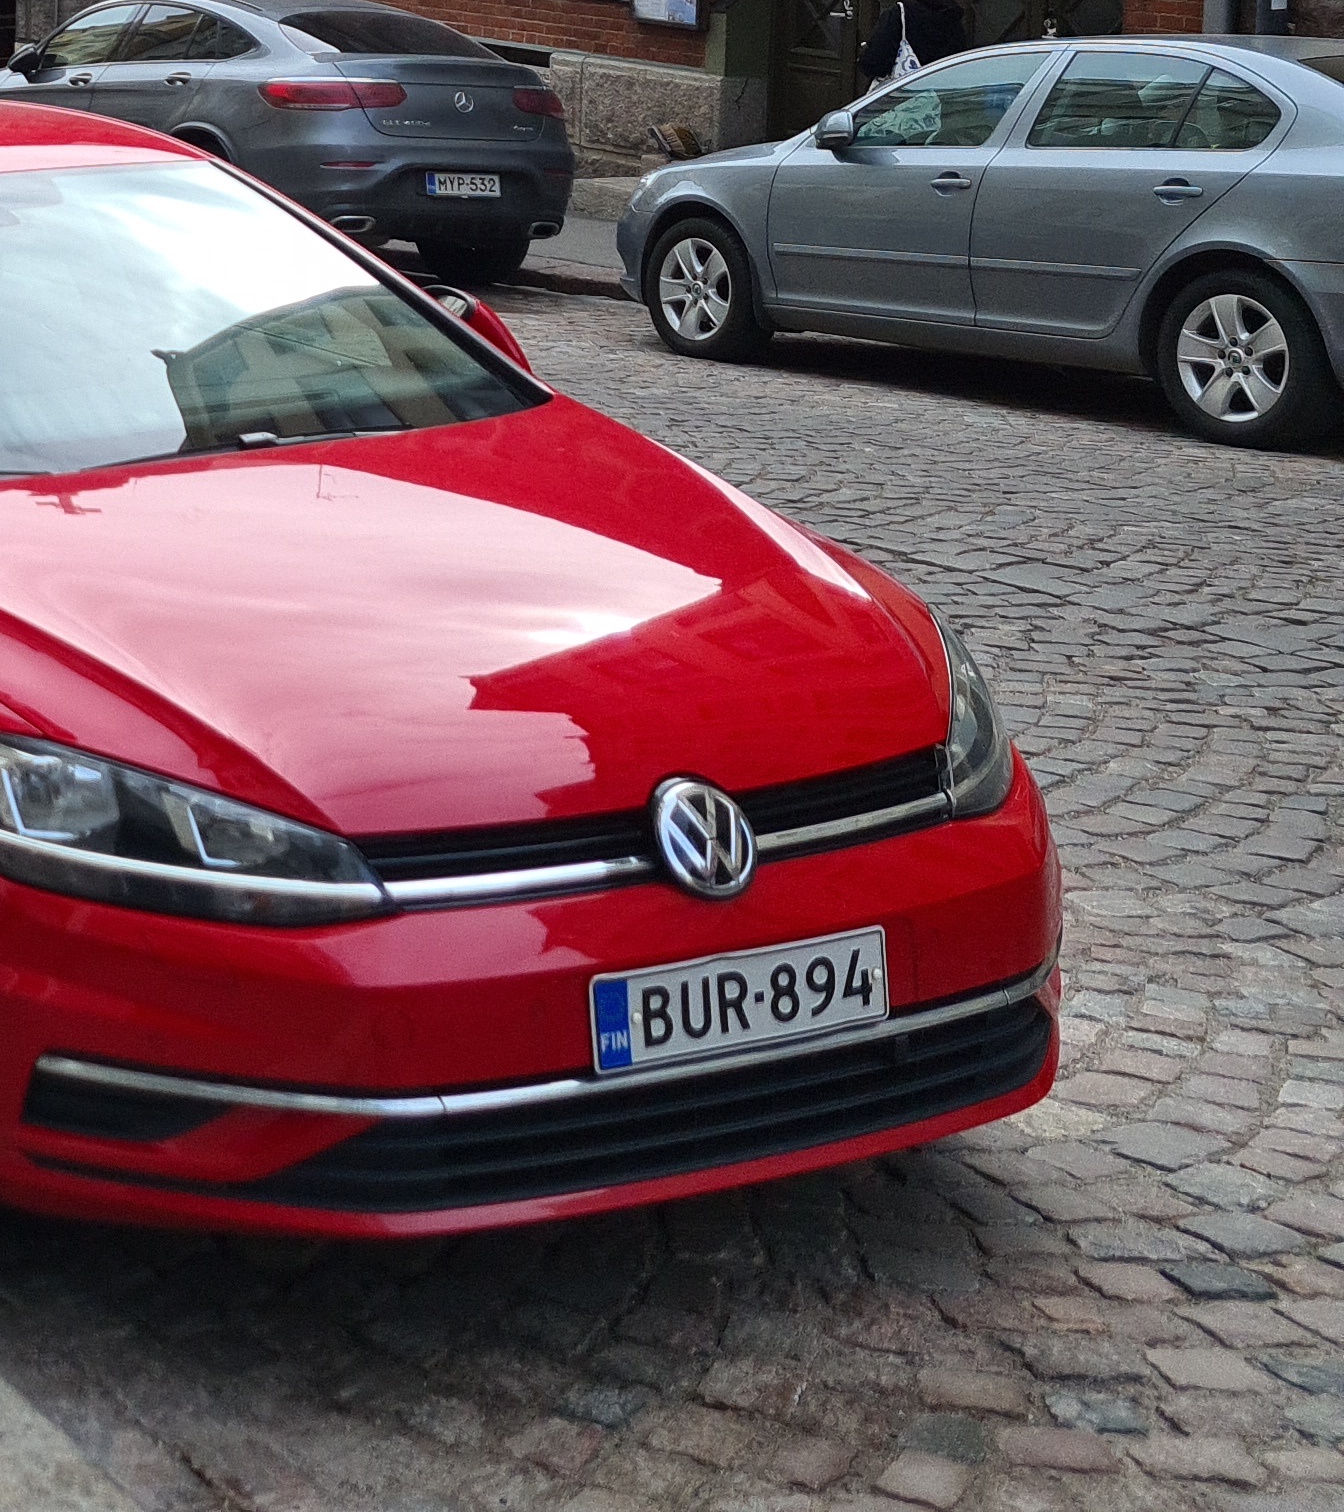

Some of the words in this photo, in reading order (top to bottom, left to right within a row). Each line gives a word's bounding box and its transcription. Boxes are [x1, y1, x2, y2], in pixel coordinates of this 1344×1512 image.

[437, 175, 497, 193] MYP-532
[641, 947, 874, 1048] BUR-894
[600, 1029, 630, 1054] FIN
